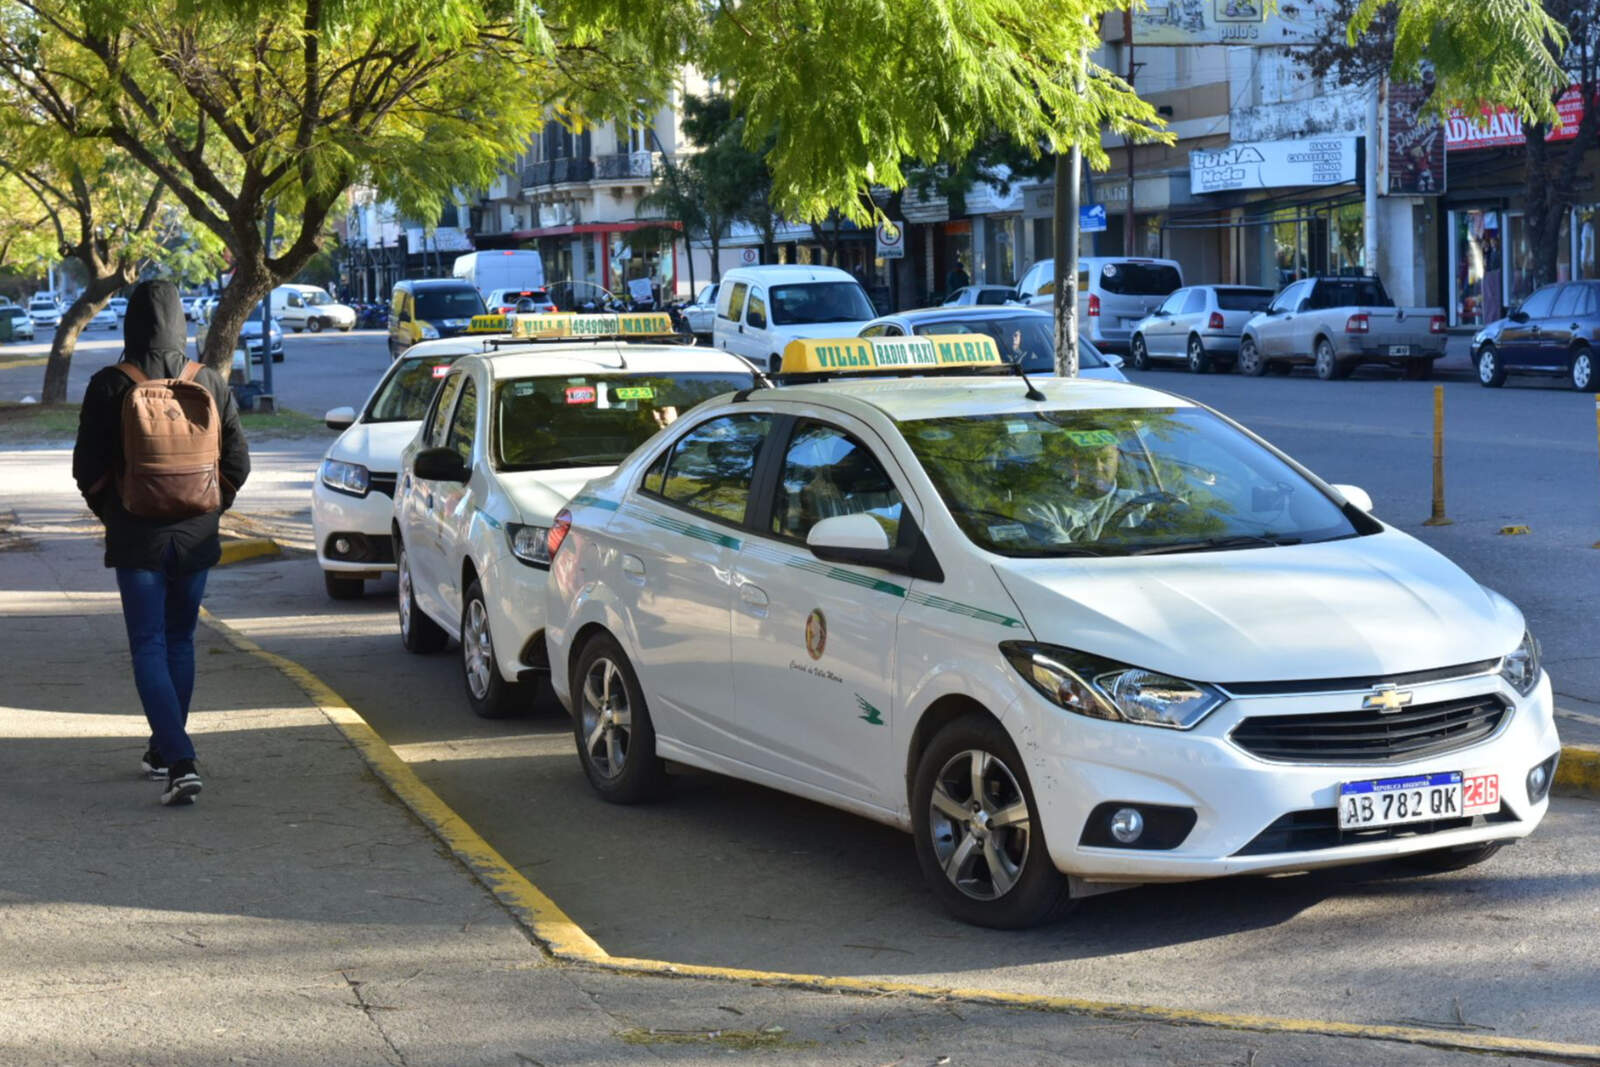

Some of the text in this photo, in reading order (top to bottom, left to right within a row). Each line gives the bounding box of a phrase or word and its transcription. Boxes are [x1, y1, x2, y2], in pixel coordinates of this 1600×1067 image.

[1310, 141, 1342, 151] DAMAS
[1193, 146, 1265, 170] LUNA
[1287, 151, 1343, 163] CABALLEROS
[1202, 167, 1246, 184] Moda
[523, 319, 564, 335] VILLA
[622, 316, 667, 333] MARIA
[815, 341, 996, 367] VILLA RADIO TAXI MARIA
[1463, 775, 1497, 808] 236
[1347, 786, 1457, 824] AB 782 QK
